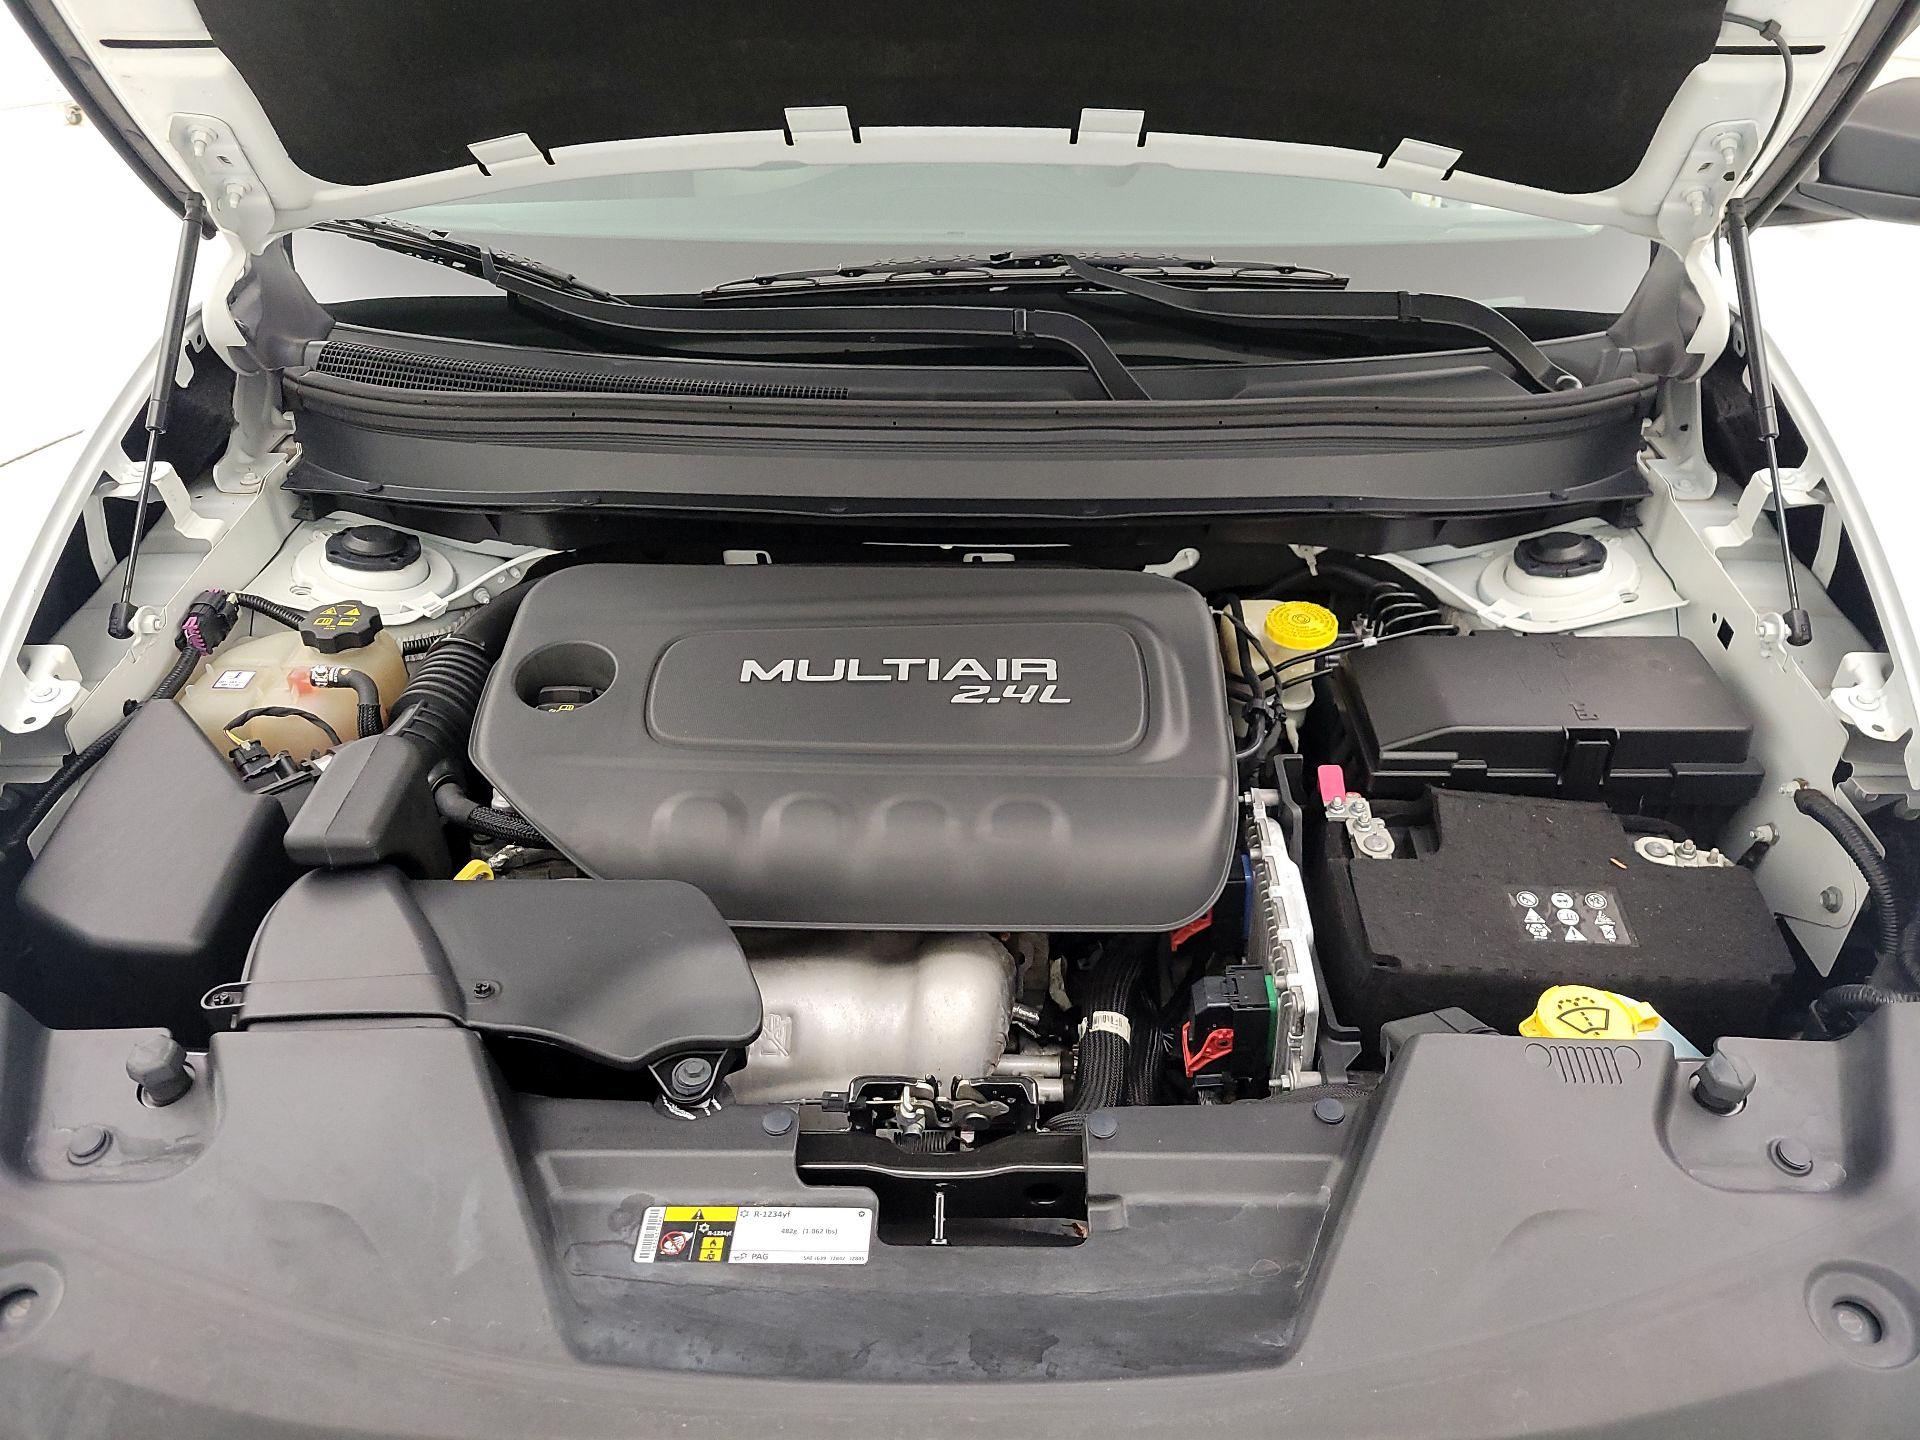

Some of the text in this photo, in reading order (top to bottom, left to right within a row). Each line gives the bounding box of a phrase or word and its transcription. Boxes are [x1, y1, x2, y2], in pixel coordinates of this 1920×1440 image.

[740, 658, 1058, 682] MULTIAIR
[949, 684, 1072, 704] 2.4L
[753, 1210, 791, 1219] R-1234yf
